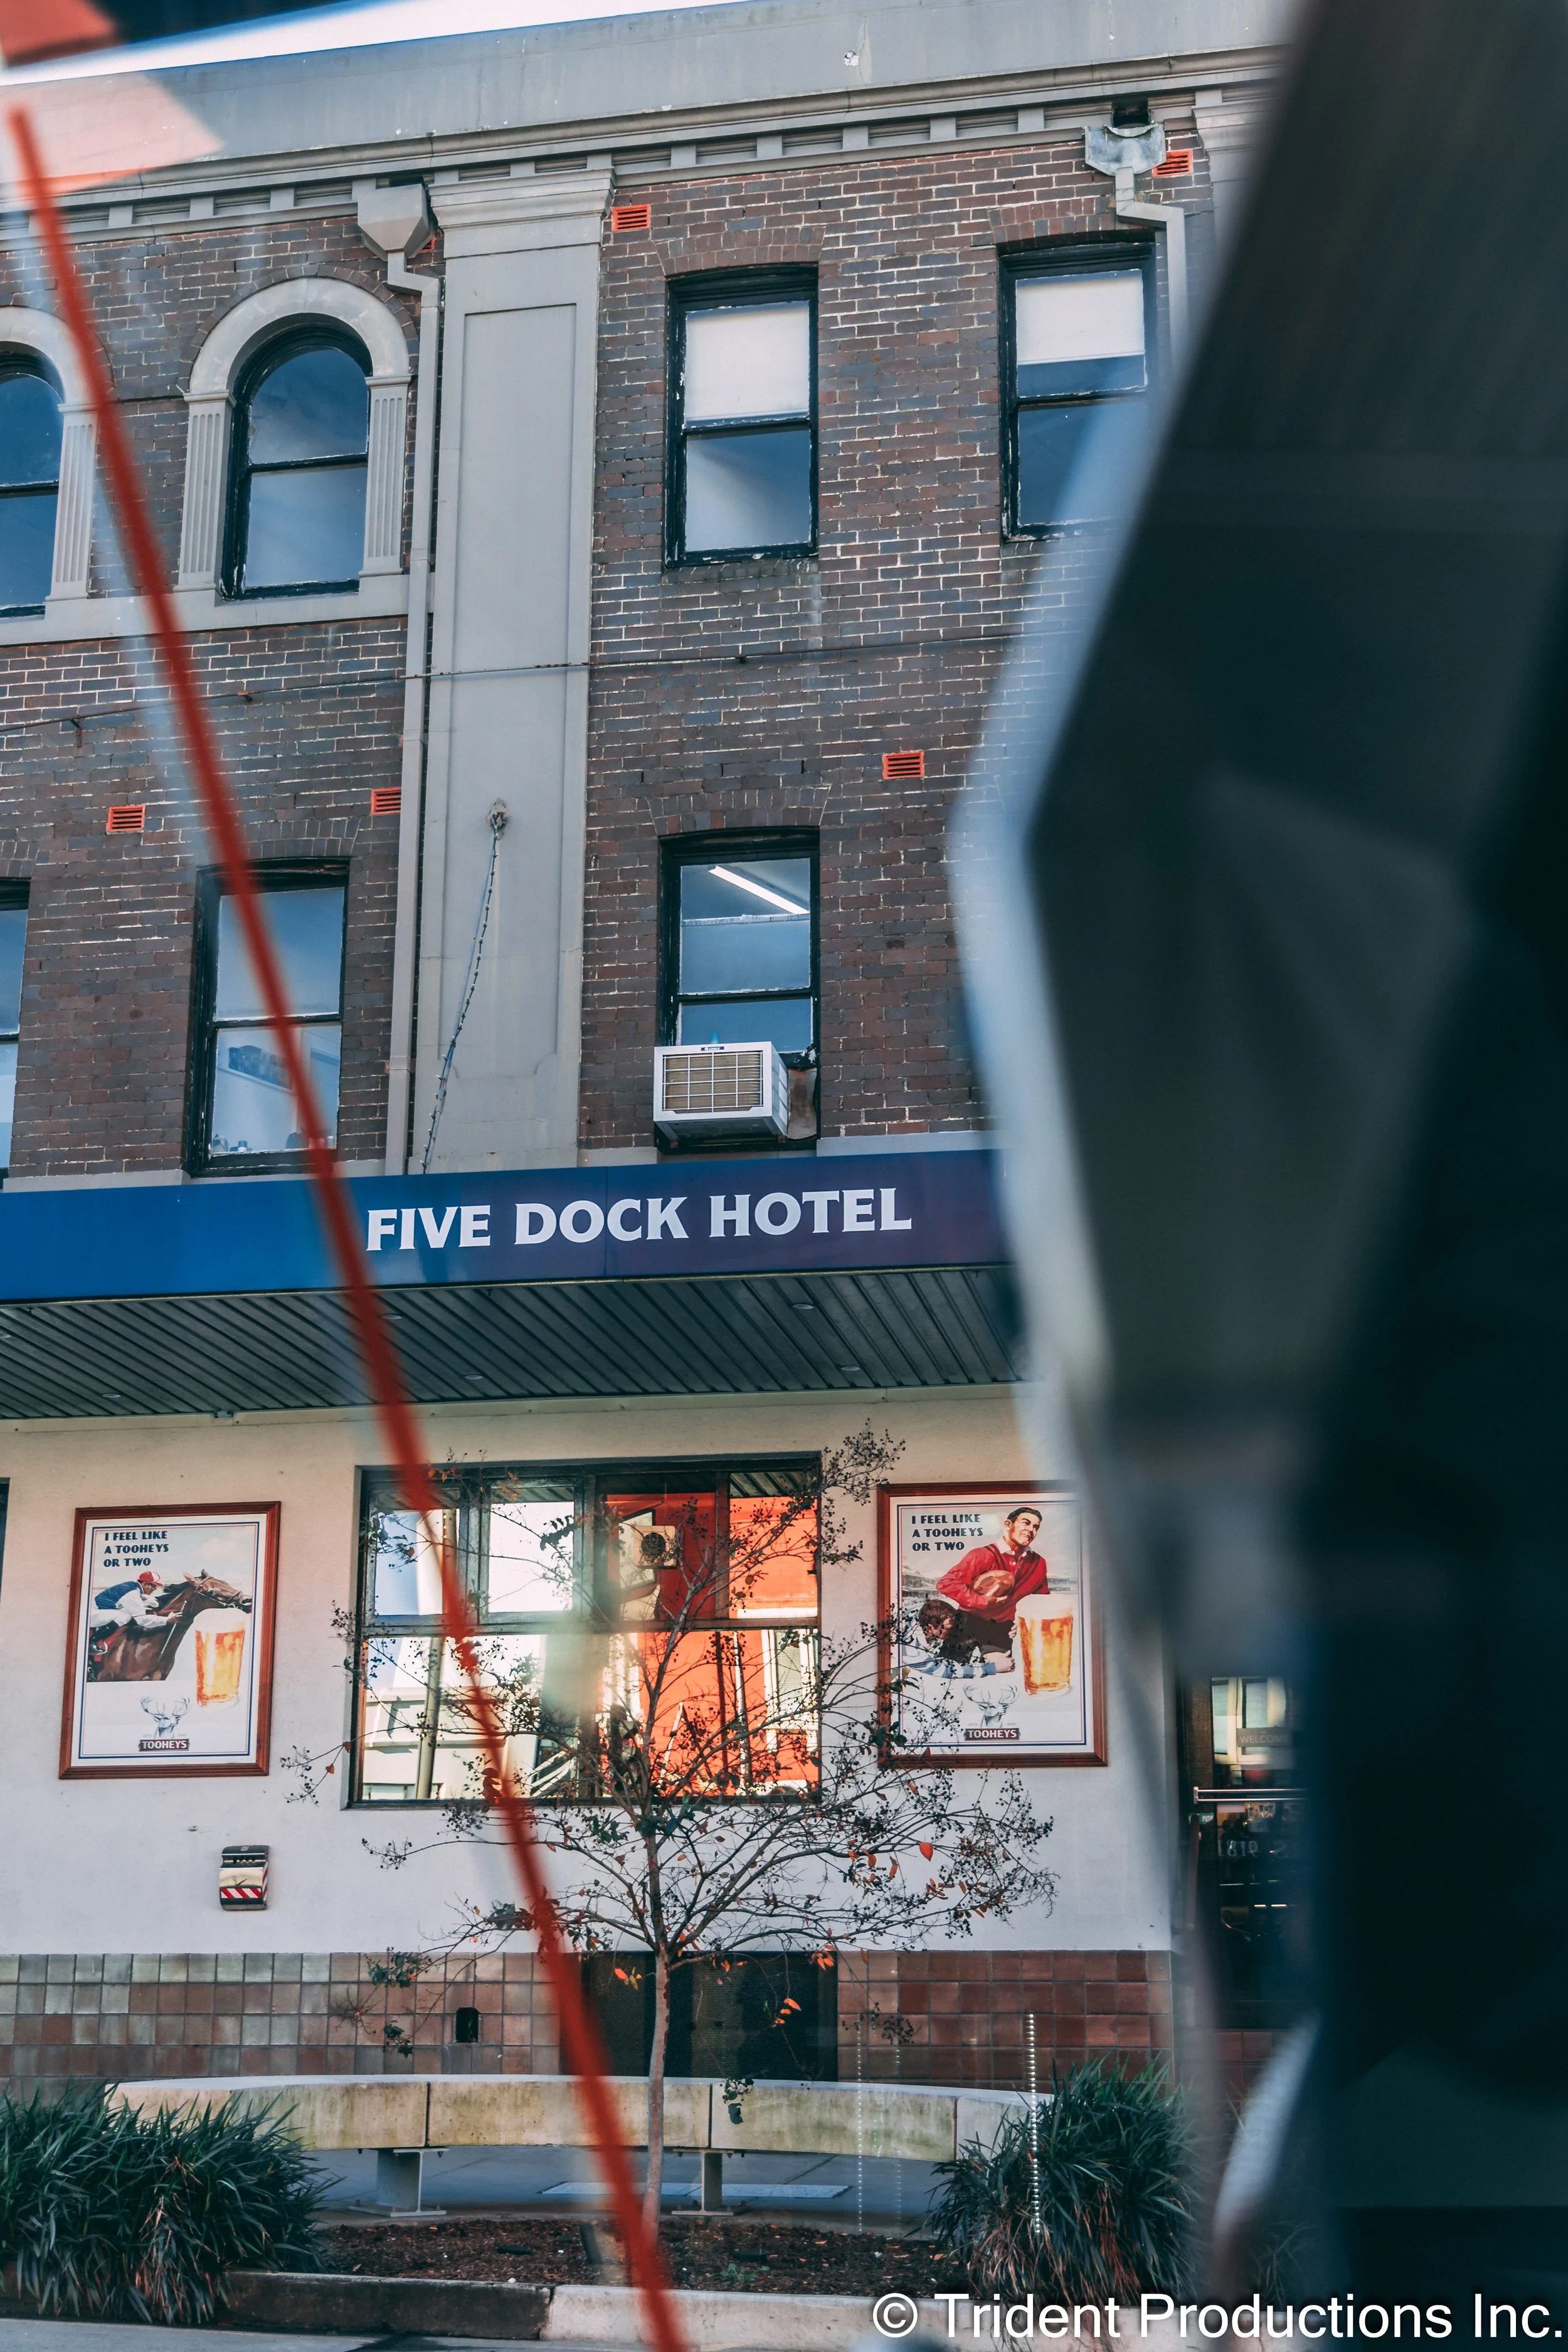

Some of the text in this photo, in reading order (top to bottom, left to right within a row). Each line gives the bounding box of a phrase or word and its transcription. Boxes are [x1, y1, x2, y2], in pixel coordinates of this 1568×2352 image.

[366, 1187, 912, 1251] FIVE DOCK HOTEL
[911, 1514, 980, 1525] I FEEL LIKE
[105, 1531, 167, 1541] I FEEL LIKE
[912, 1528, 983, 1538] A TOOHEYS
[104, 1544, 169, 1554] A TOOHEYS
[912, 1541, 965, 1552] OR TWO
[103, 1557, 151, 1567] OR TWO
[967, 1729, 1017, 1739] TOOHEYS
[1239, 1735, 1290, 1743] WELCOME
[142, 1740, 187, 1749] TOOHEYS
